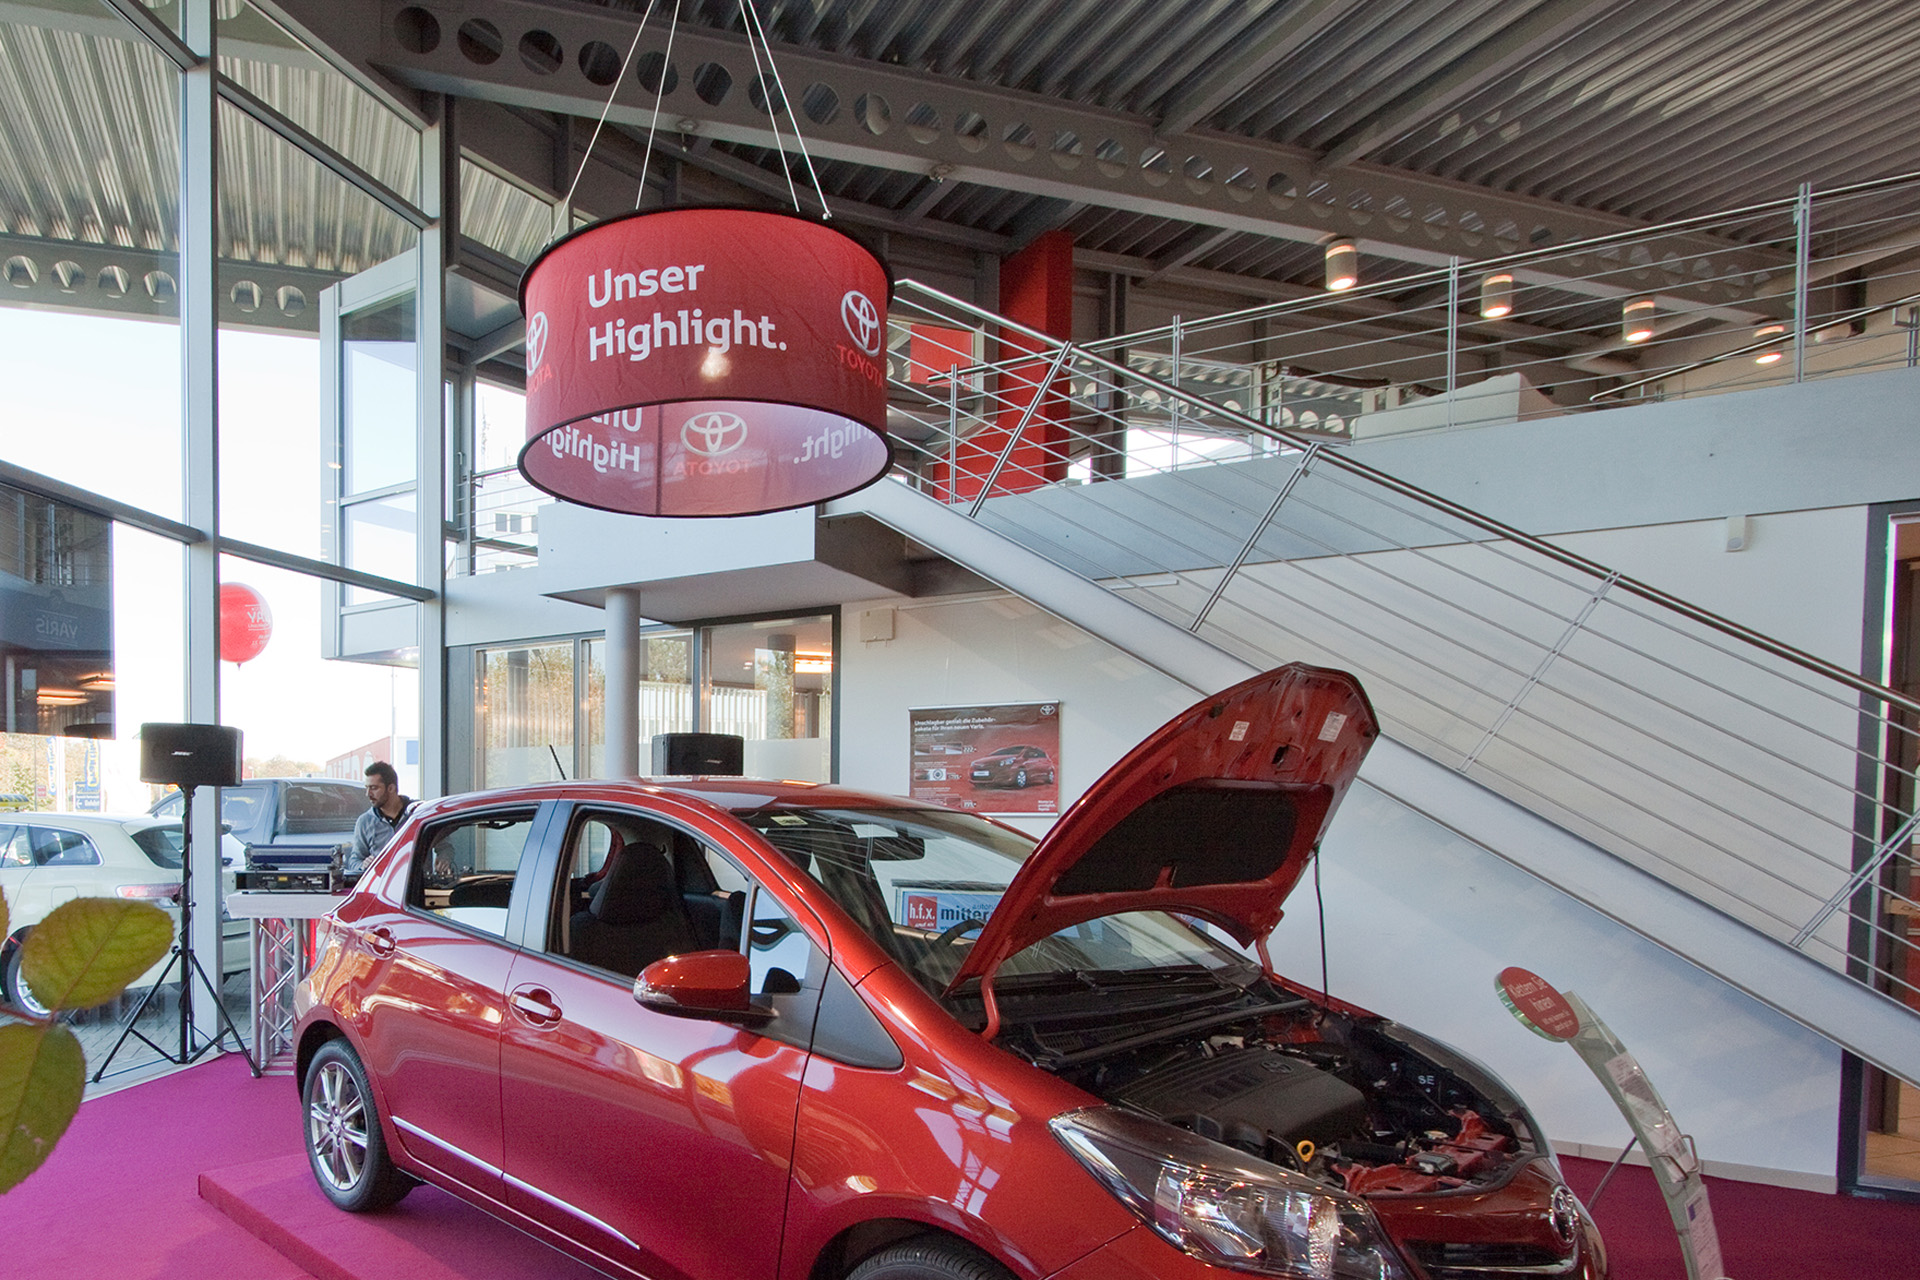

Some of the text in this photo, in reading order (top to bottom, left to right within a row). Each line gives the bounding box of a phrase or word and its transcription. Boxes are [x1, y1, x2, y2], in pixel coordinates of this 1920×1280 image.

[588, 264, 705, 309] Unser
[589, 308, 788, 362] Highlight.
[909, 903, 936, 920] h.f.x.
[941, 905, 993, 920] mitter
[1506, 975, 1549, 999] Klettern Sie
